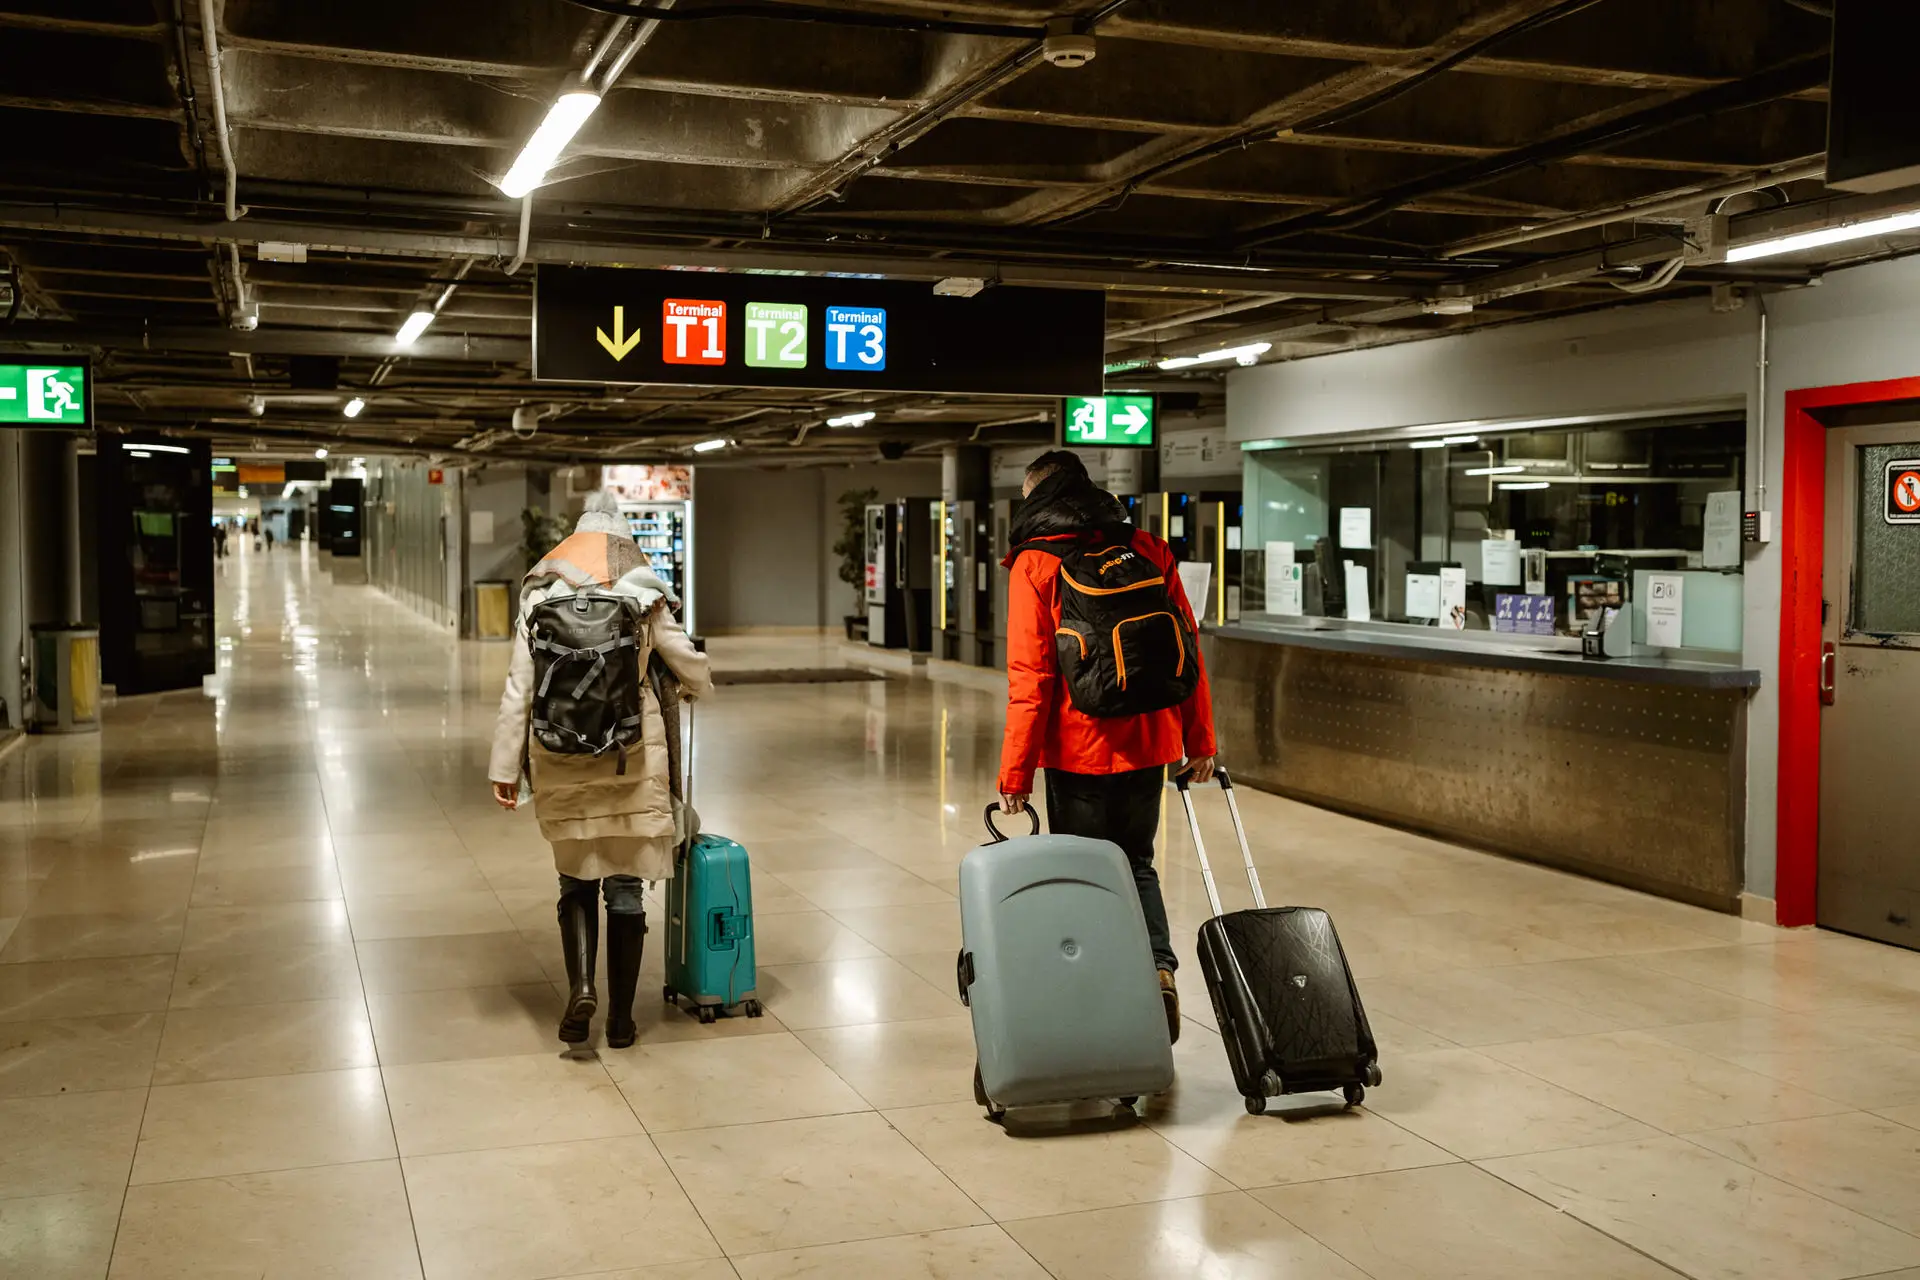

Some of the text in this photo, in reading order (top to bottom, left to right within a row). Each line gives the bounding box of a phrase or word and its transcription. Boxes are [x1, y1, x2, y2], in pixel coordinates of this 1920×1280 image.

[668, 303, 723, 317] Terminal
[751, 306, 803, 320] Terminal
[830, 310, 882, 324] Terminal
[666, 315, 723, 358] T1
[747, 319, 806, 361] T2
[828, 324, 884, 365] T3
